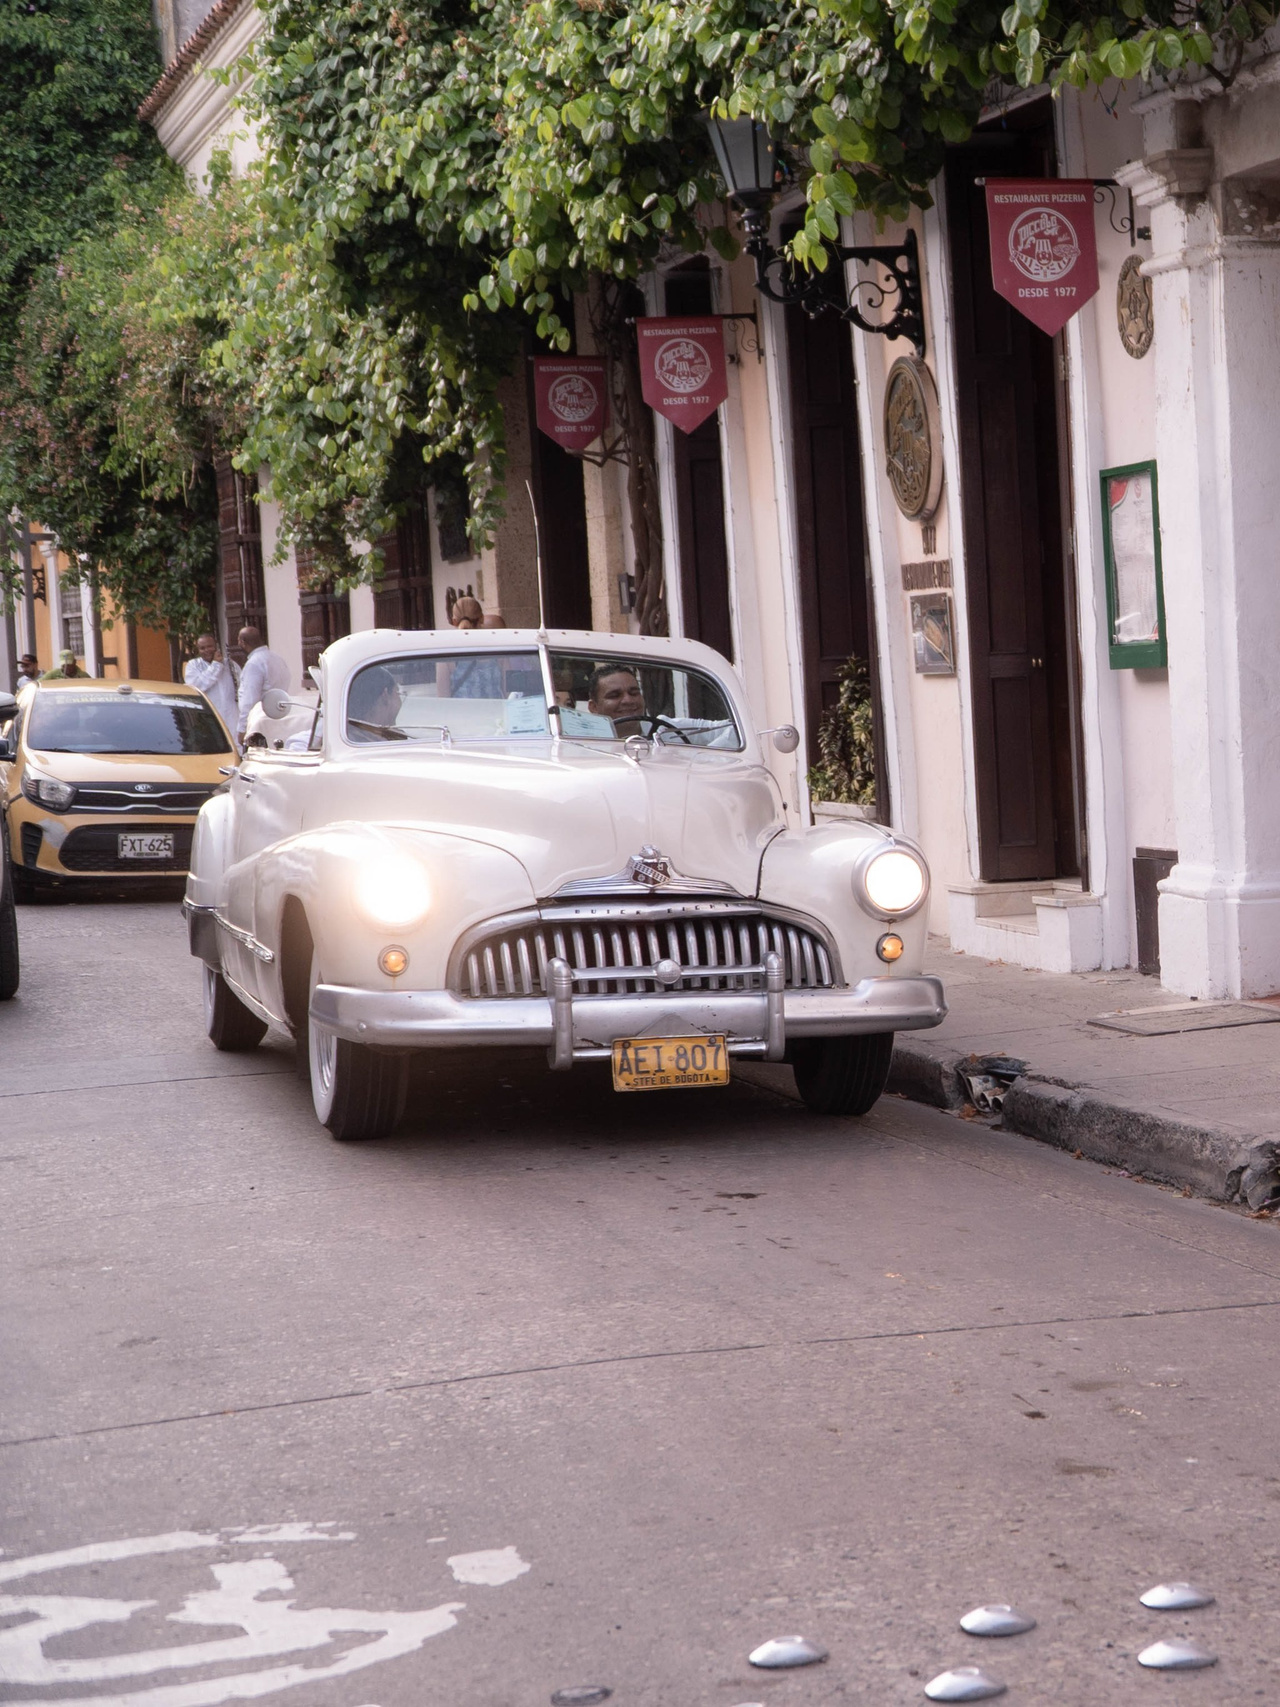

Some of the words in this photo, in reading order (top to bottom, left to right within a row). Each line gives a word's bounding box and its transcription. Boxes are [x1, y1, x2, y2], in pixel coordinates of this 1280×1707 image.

[994, 194, 1050, 203] RESTAURANTE
[1051, 194, 1086, 203] PIZZERIA
[1018, 288, 1049, 298] DESDE
[1054, 287, 1077, 297] 1977
[643, 327, 688, 336] RESTAURANTE
[689, 326, 717, 334] PIZZERIA
[663, 397, 688, 405] DESDE
[692, 396, 710, 404] 1977
[619, 1046, 665, 1075] AEI
[675, 1044, 722, 1072] 807
[675, 1073, 710, 1083] BOGOTA
